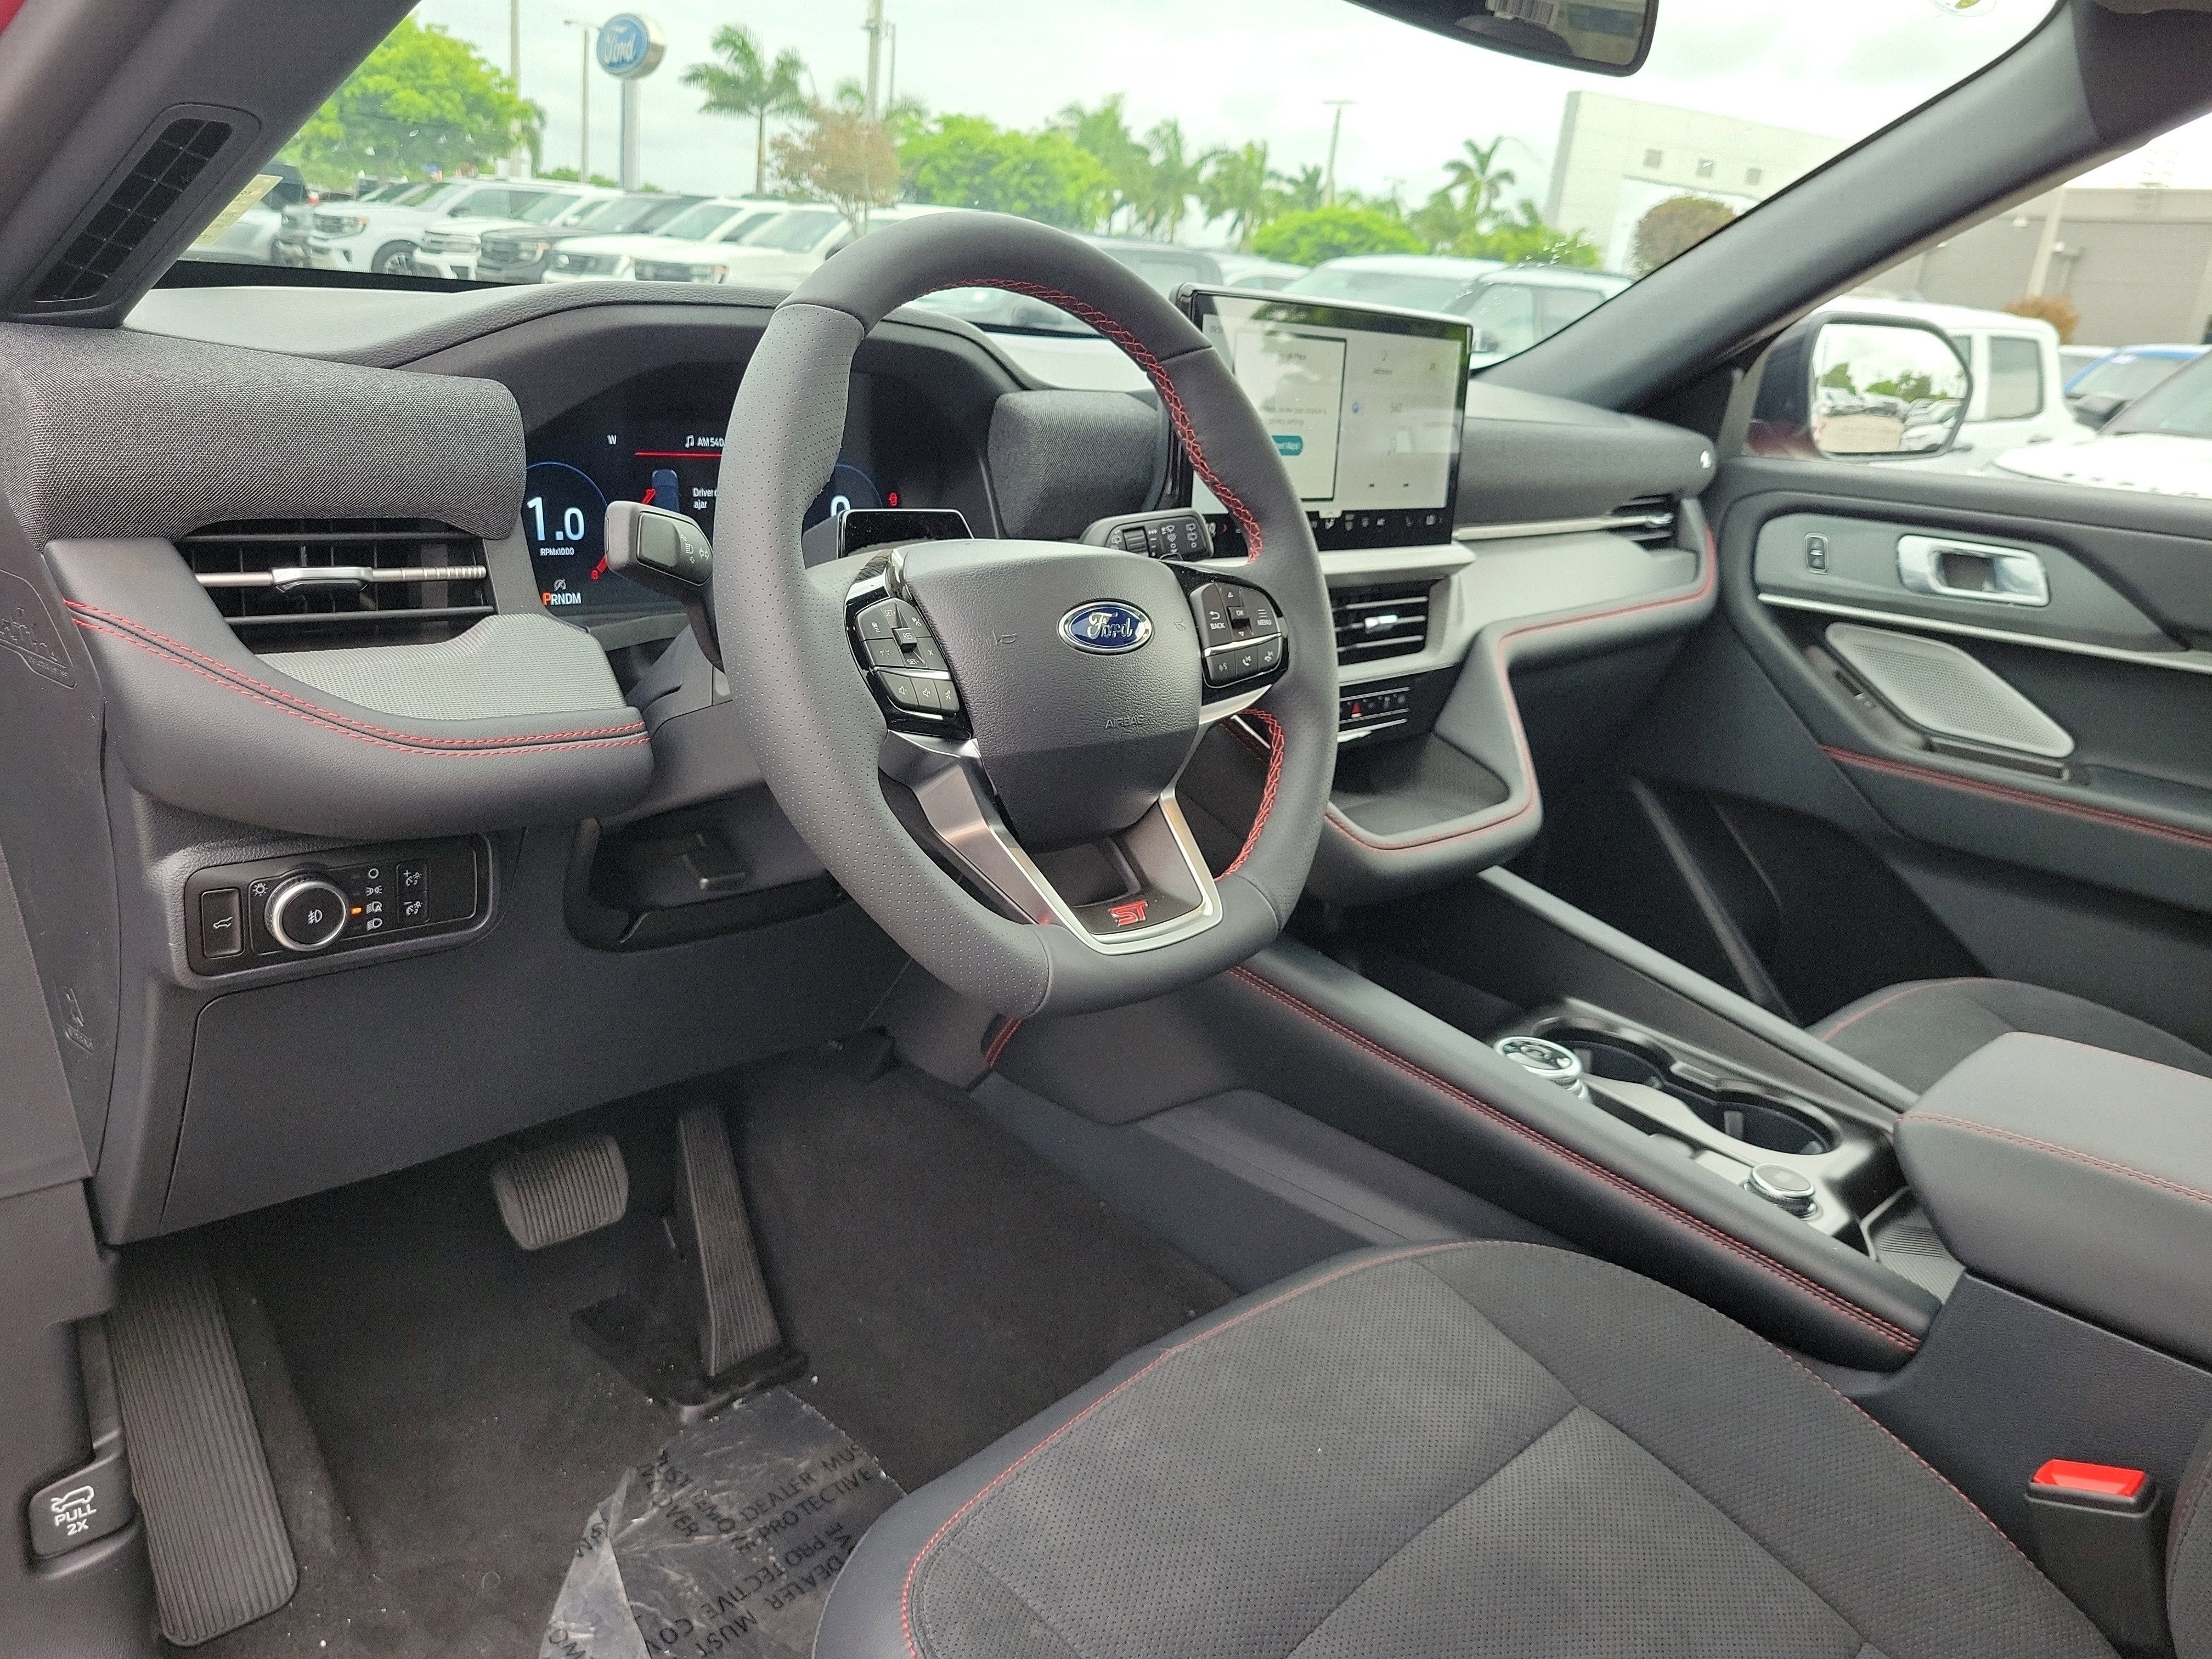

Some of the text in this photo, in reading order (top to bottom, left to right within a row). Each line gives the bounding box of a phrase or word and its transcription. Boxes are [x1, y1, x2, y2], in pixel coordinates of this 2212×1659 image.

[604, 25, 637, 63] Ford
[607, 435, 617, 445] W
[692, 487, 713, 497] Driver
[693, 499, 707, 510] ajar
[527, 496, 584, 541] 1.0
[539, 547, 575, 556] RPMx1000
[542, 592, 582, 605] PRNDM
[1087, 612, 1133, 640] Ford
[1109, 900, 1148, 927] ST
[740, 1471, 816, 1522] DEALER
[758, 1467, 873, 1538] PROTECTIVE
[54, 1504, 97, 1527] PULL
[66, 1519, 89, 1536] 2X
[701, 1535, 826, 1621] PROTECTIVE
[697, 1555, 845, 1658] DEALER MUST
